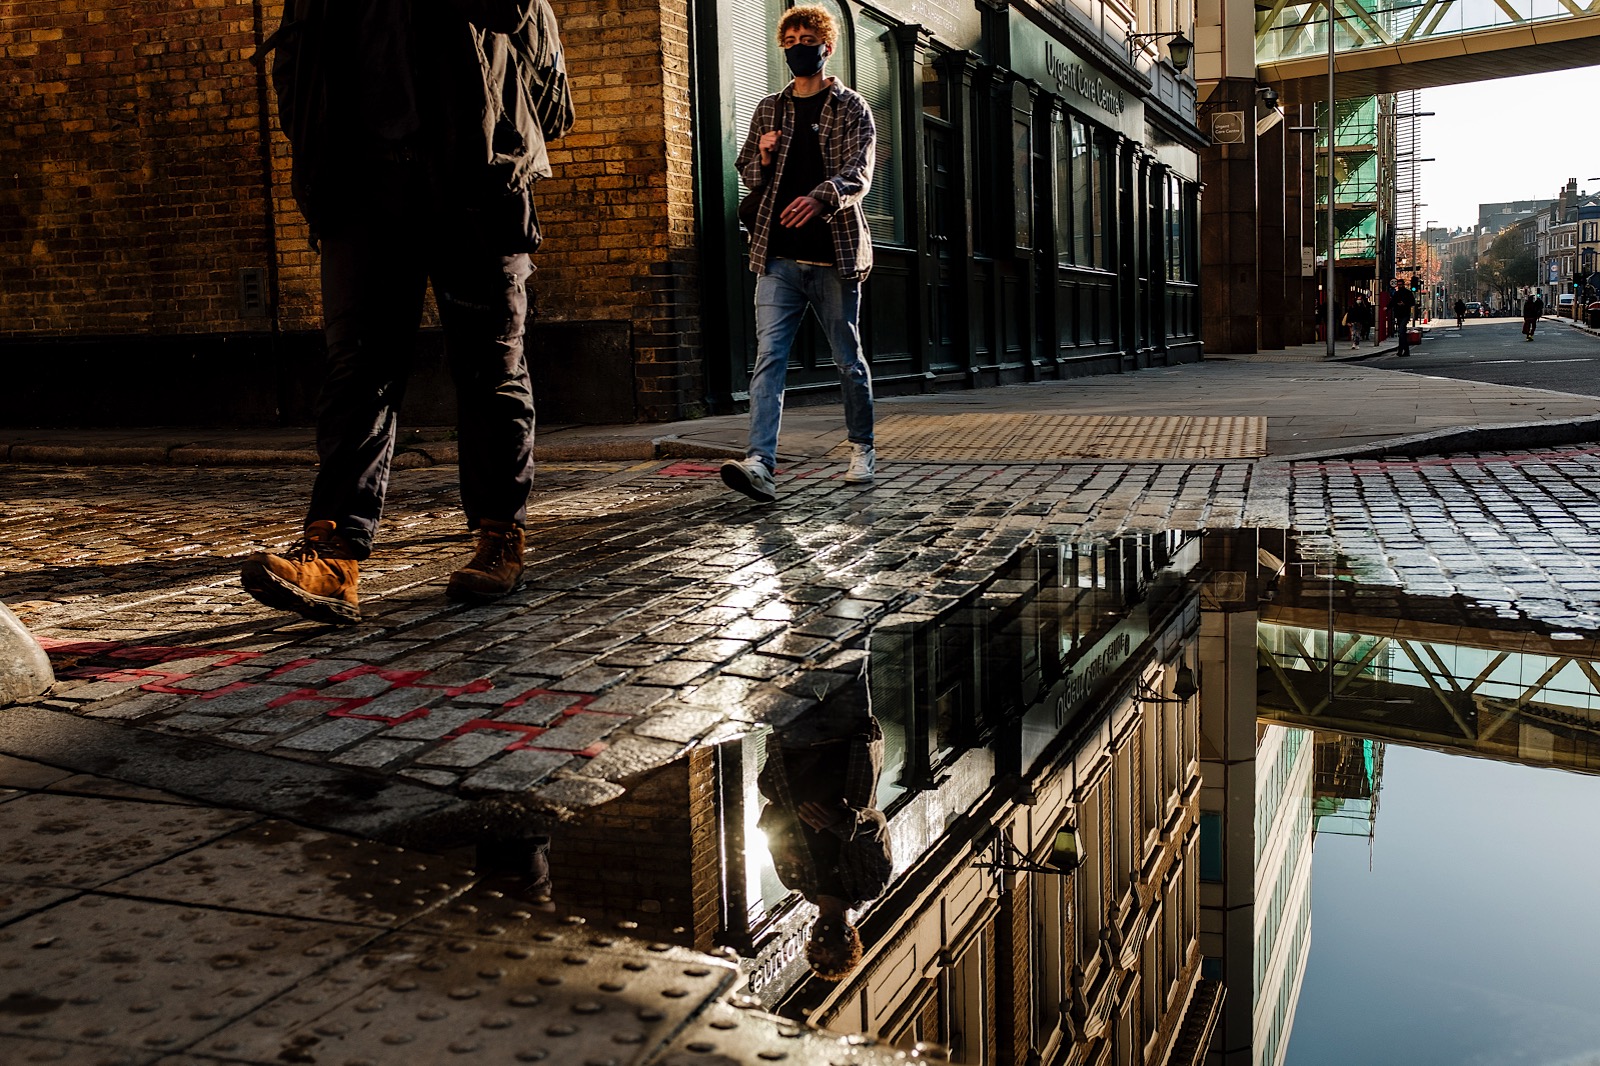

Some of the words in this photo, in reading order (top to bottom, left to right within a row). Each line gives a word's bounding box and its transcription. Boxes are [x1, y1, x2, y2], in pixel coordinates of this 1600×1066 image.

[1045, 41, 1076, 91] Urgent
[1077, 65, 1096, 102] Care
[1096, 77, 1119, 117] Centre
